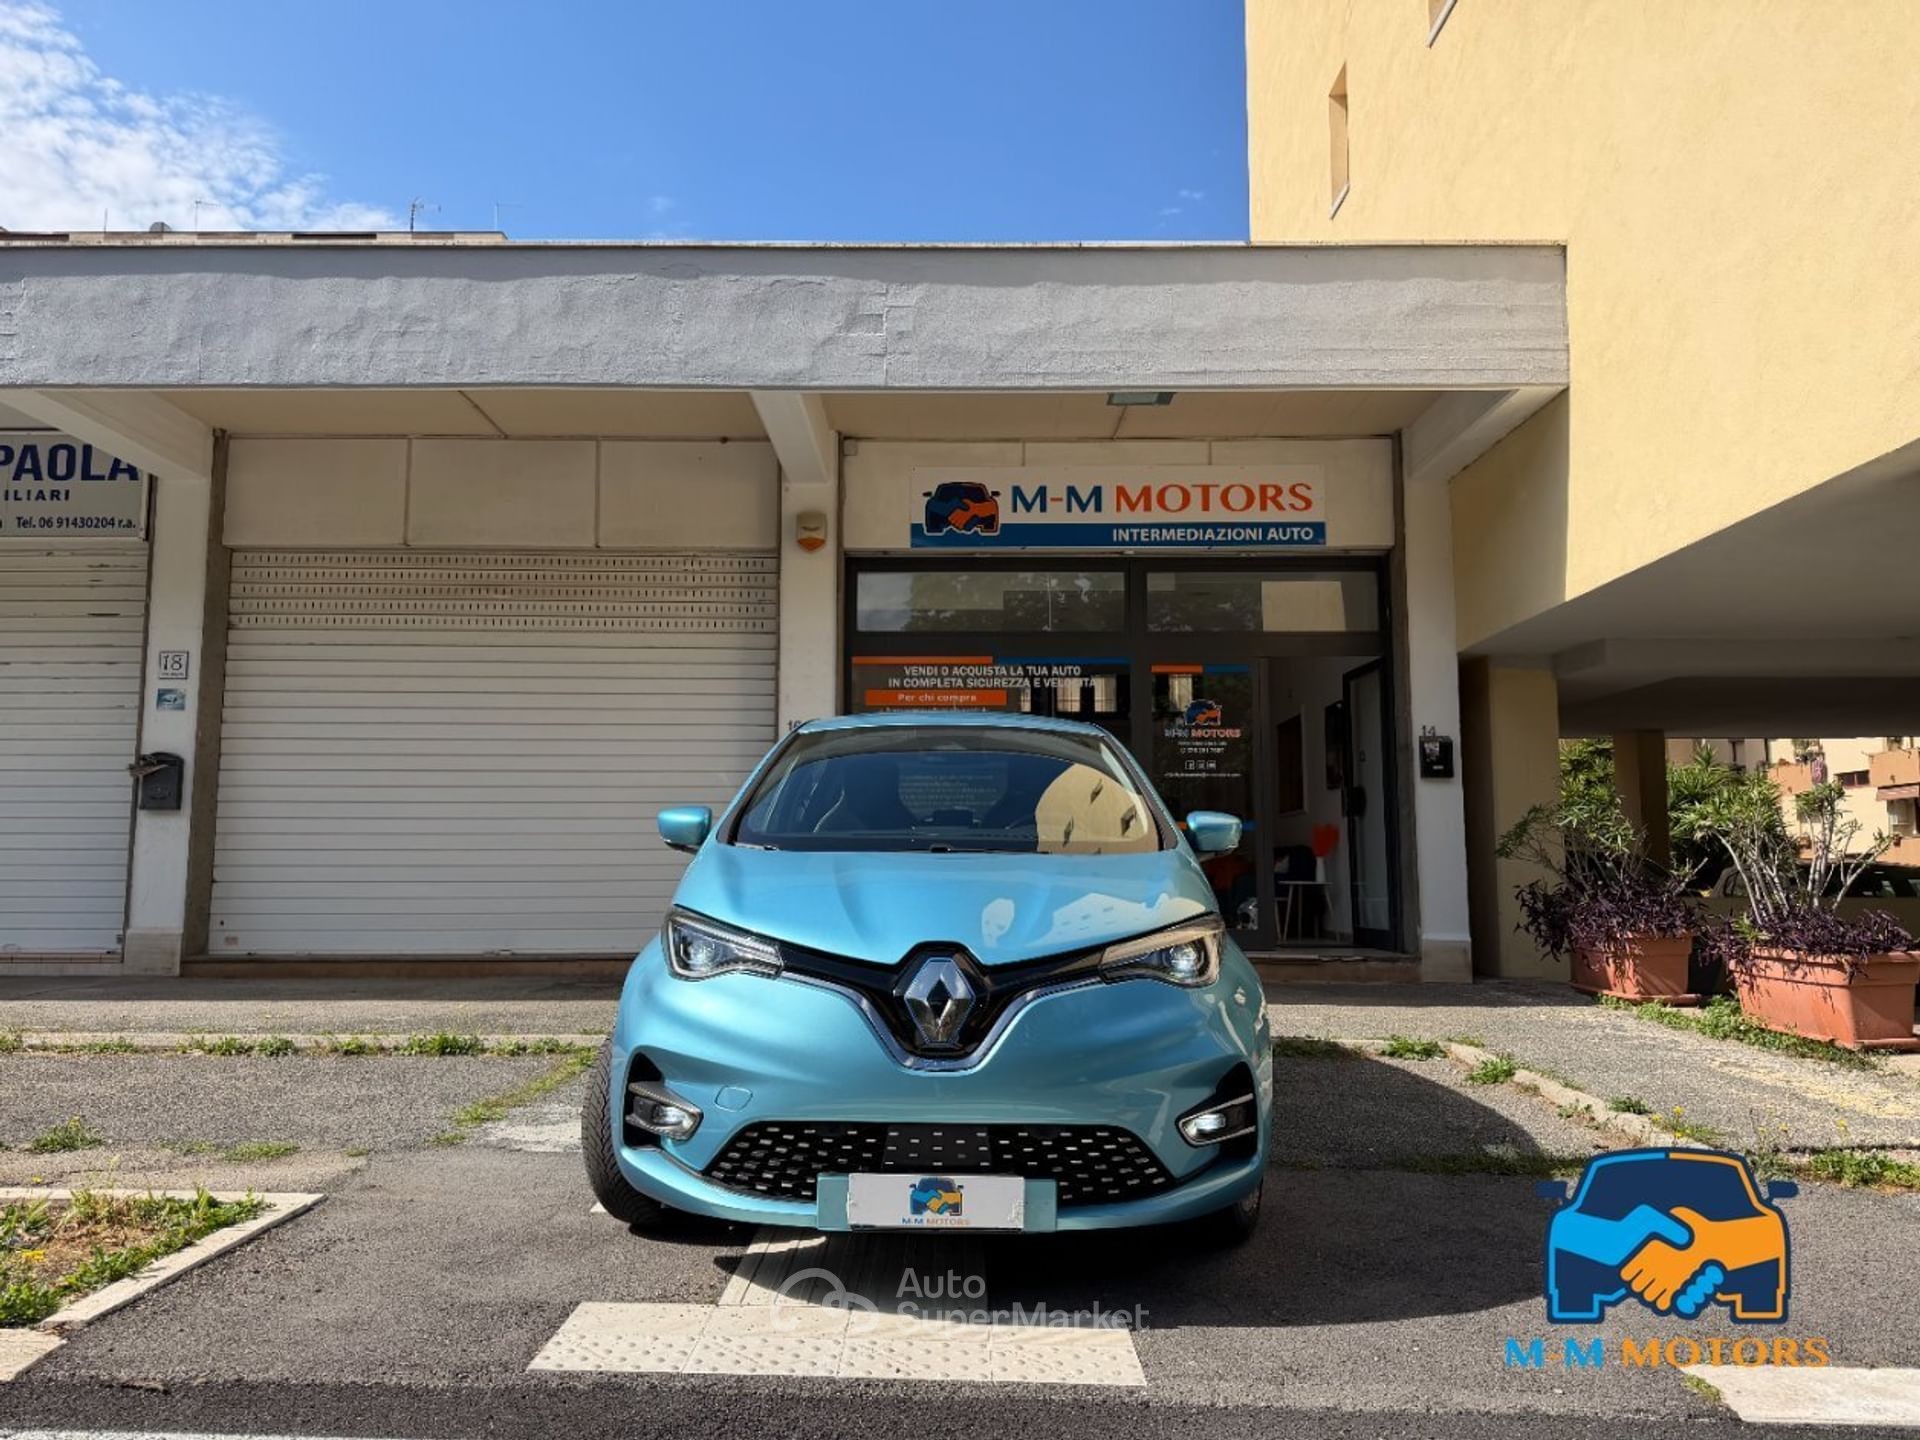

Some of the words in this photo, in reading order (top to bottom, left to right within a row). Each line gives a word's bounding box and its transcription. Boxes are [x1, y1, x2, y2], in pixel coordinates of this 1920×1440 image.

[1011, 485, 1103, 513] M-M
[1115, 483, 1314, 513] MOTORS
[16, 516, 36, 529] Tel.
[38, 516, 54, 529] 06
[56, 516, 116, 529] 91430204
[117, 518, 136, 529] r.a.
[1112, 528, 1263, 542] INTERMEDIAZIONI
[1267, 527, 1314, 541] AUTO
[163, 654, 184, 671] 18
[904, 666, 938, 676] VENDI
[952, 666, 1008, 676] ACQUISTA
[1010, 666, 1024, 676] LA
[1026, 666, 1049, 676] TUA
[1051, 666, 1082, 676] AUTO
[888, 678, 900, 688] IN
[903, 678, 963, 688] COMPLETA
[965, 678, 1031, 688] SICUREZZA
[1033, 678, 1041, 688] E
[898, 694, 915, 702] Per
[919, 694, 934, 702] chi
[927, 1218, 970, 1226] MOTORS
